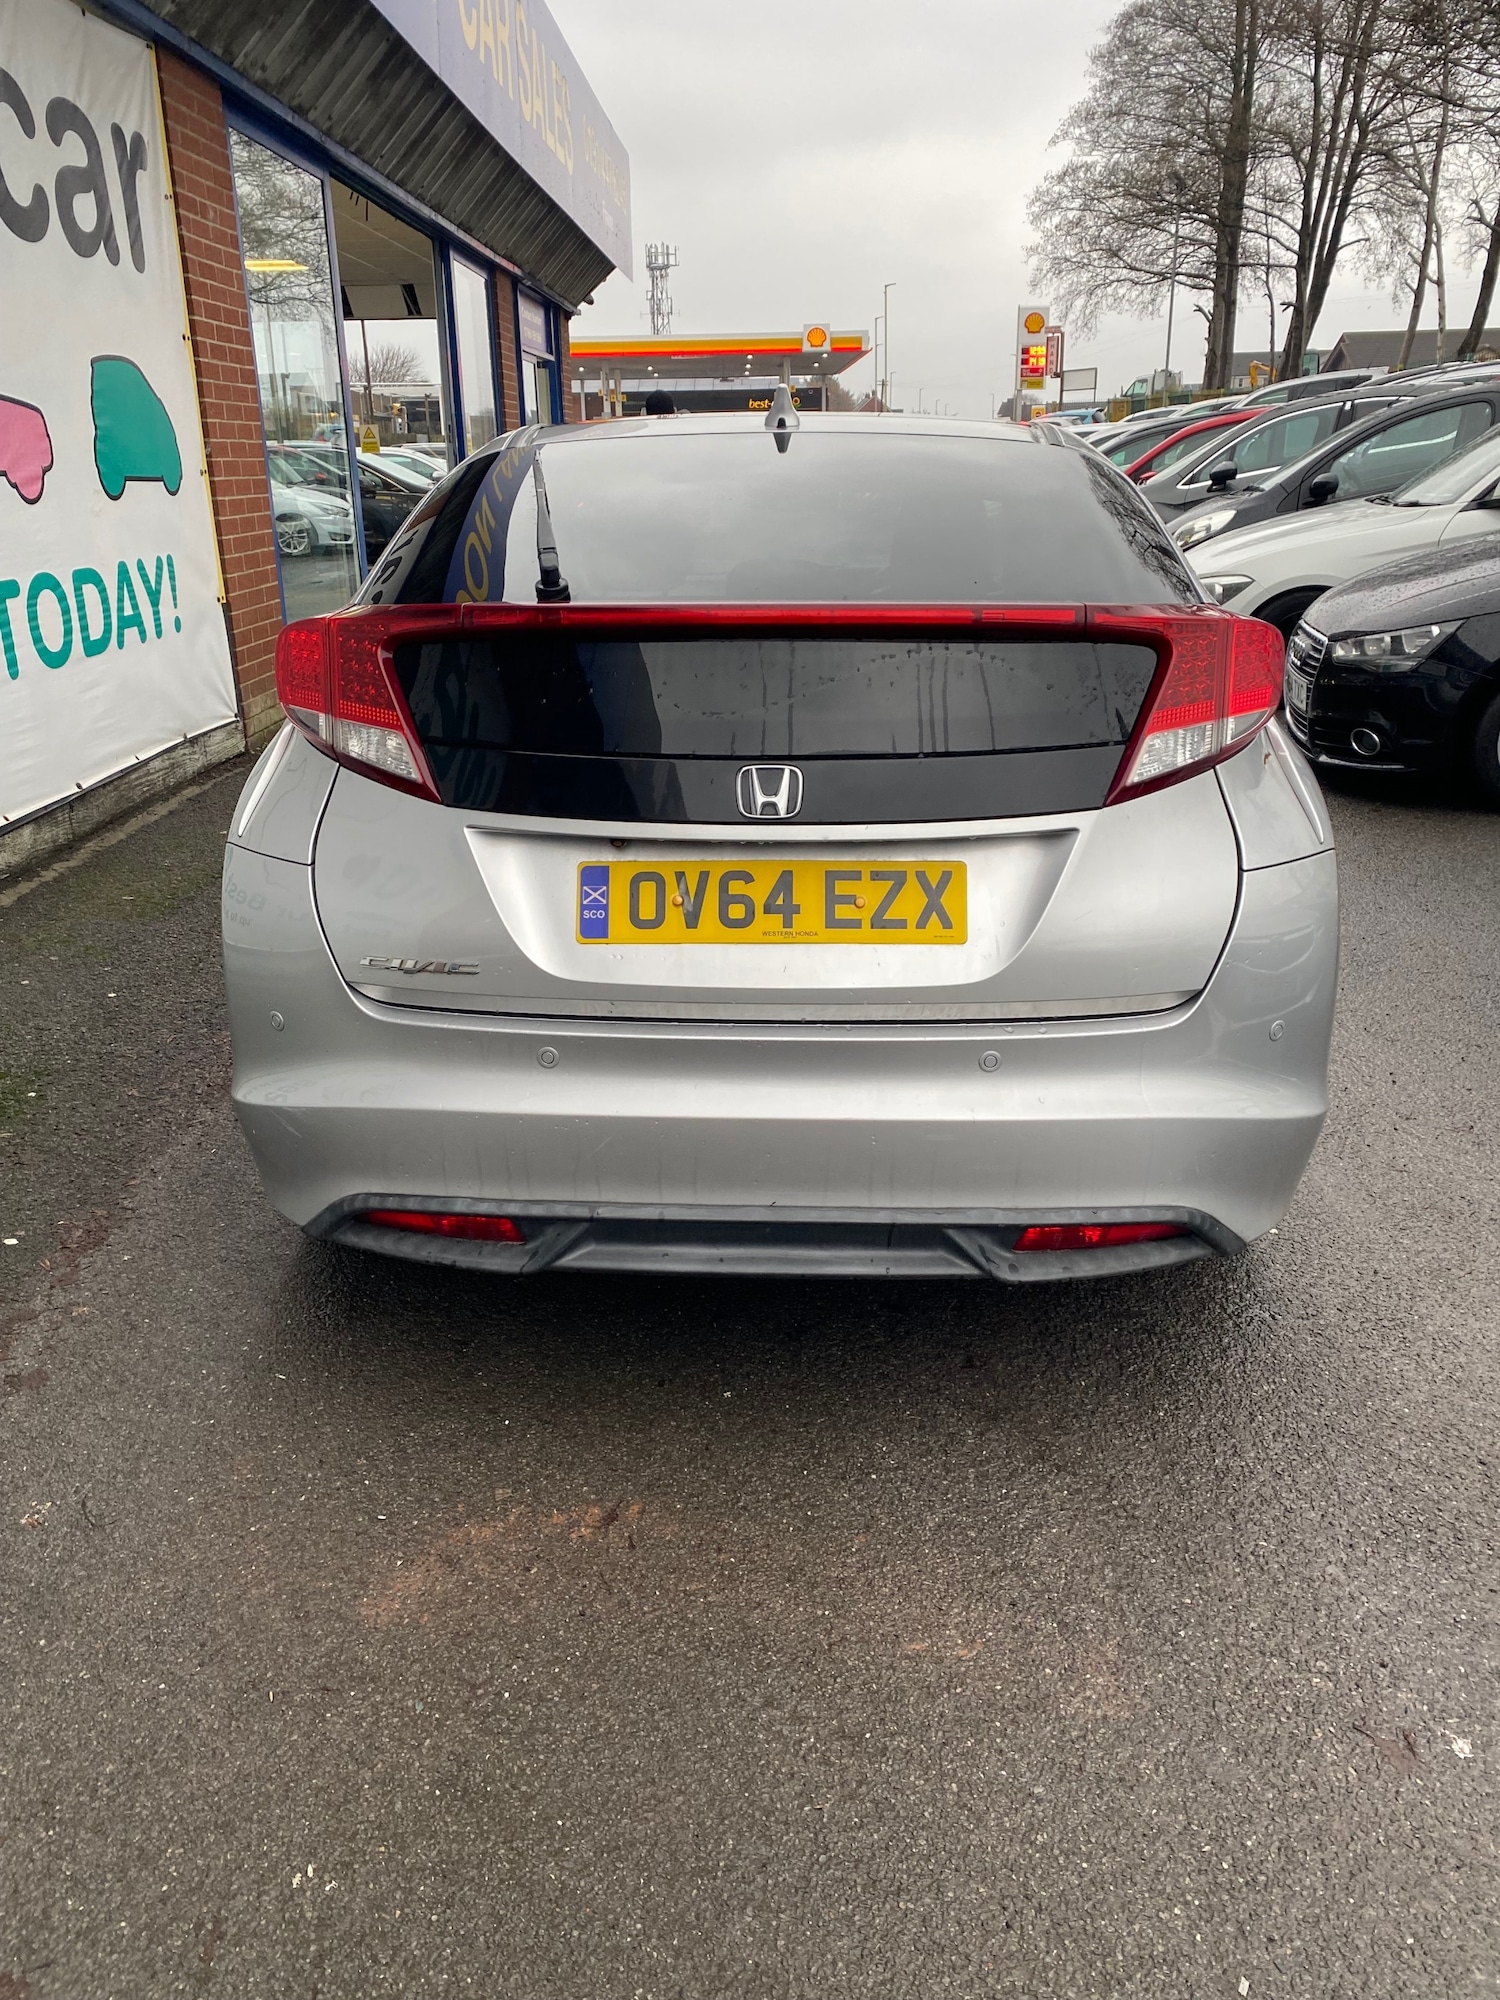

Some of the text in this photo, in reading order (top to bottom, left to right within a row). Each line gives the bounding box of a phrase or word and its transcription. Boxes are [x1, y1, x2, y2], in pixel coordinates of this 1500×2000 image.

[516, 0, 574, 176] SALES
[749, 398, 774, 409] best-
[0, 553, 182, 681] TODAY!
[629, 870, 953, 930] OV64 EZX
[582, 909, 606, 919] SCO
[761, 930, 819, 938] WESTERN HONDA
[359, 955, 481, 975] CIVIC
